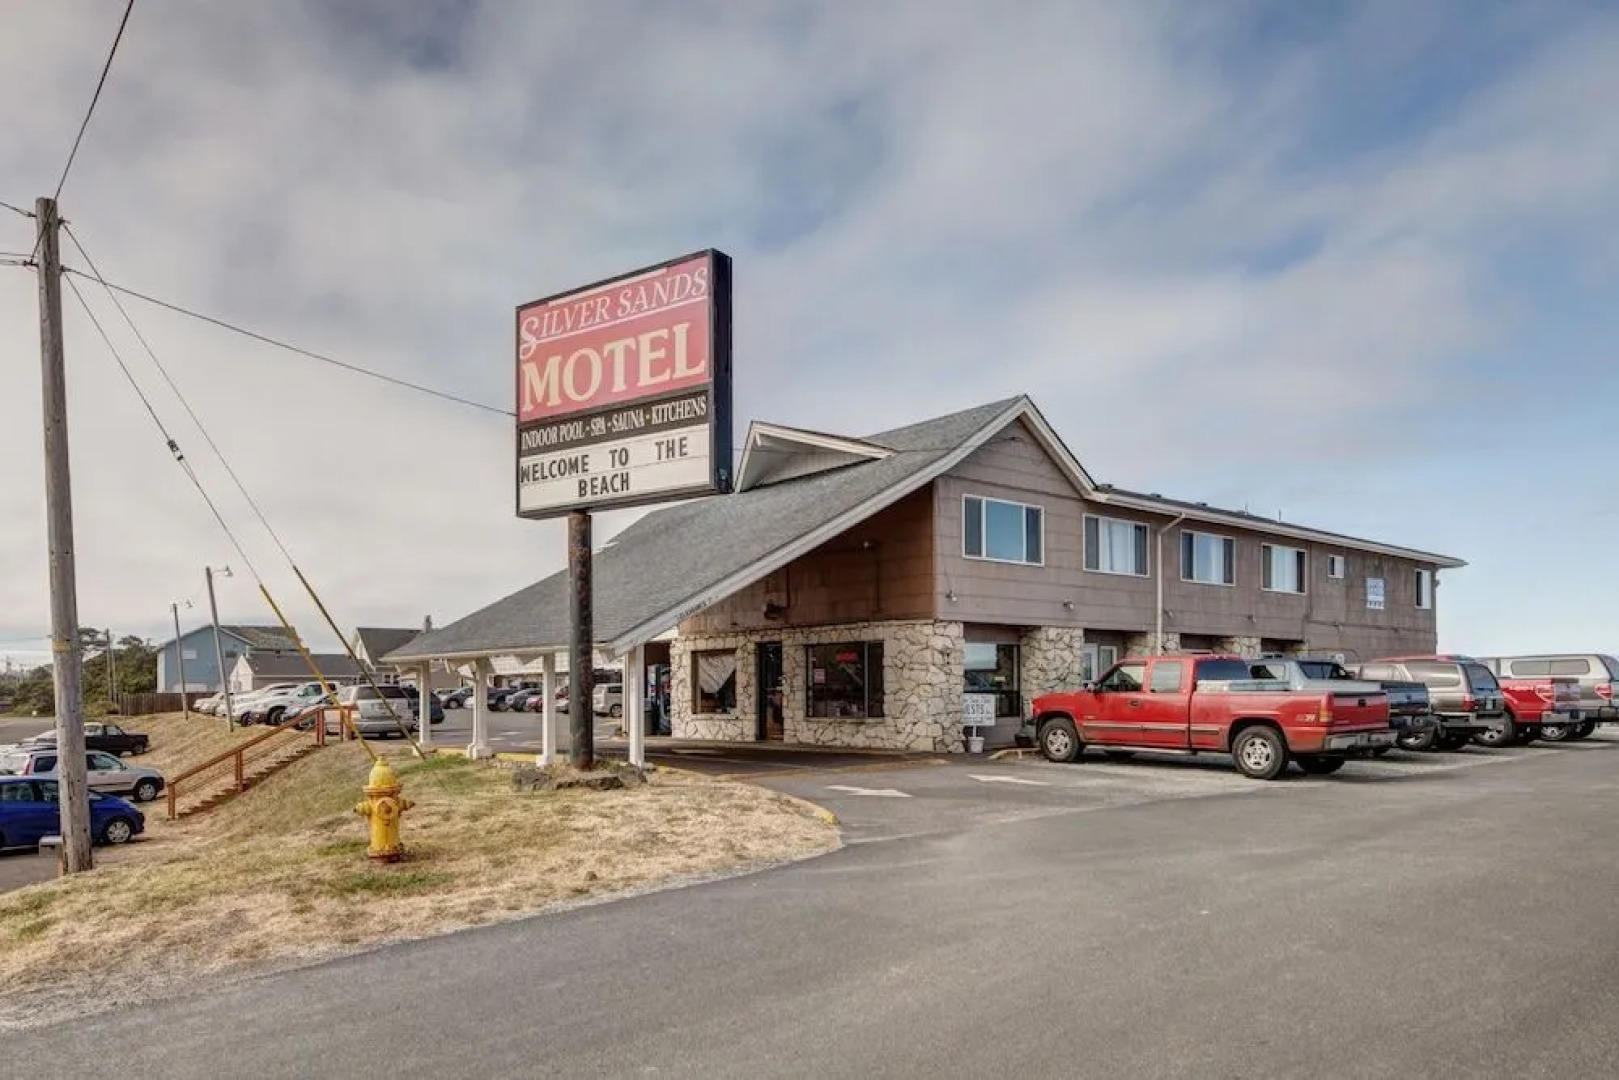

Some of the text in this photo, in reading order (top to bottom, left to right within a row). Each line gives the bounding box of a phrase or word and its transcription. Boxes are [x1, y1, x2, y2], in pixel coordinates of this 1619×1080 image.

[520, 266, 708, 360] SILVER SANDS
[522, 321, 706, 412] MOTEL
[521, 395, 707, 450] INDOOR POOL SPA SAUNA KITCHENS
[520, 436, 688, 484] WELCOME TO THE
[578, 472, 630, 498] BEACH
